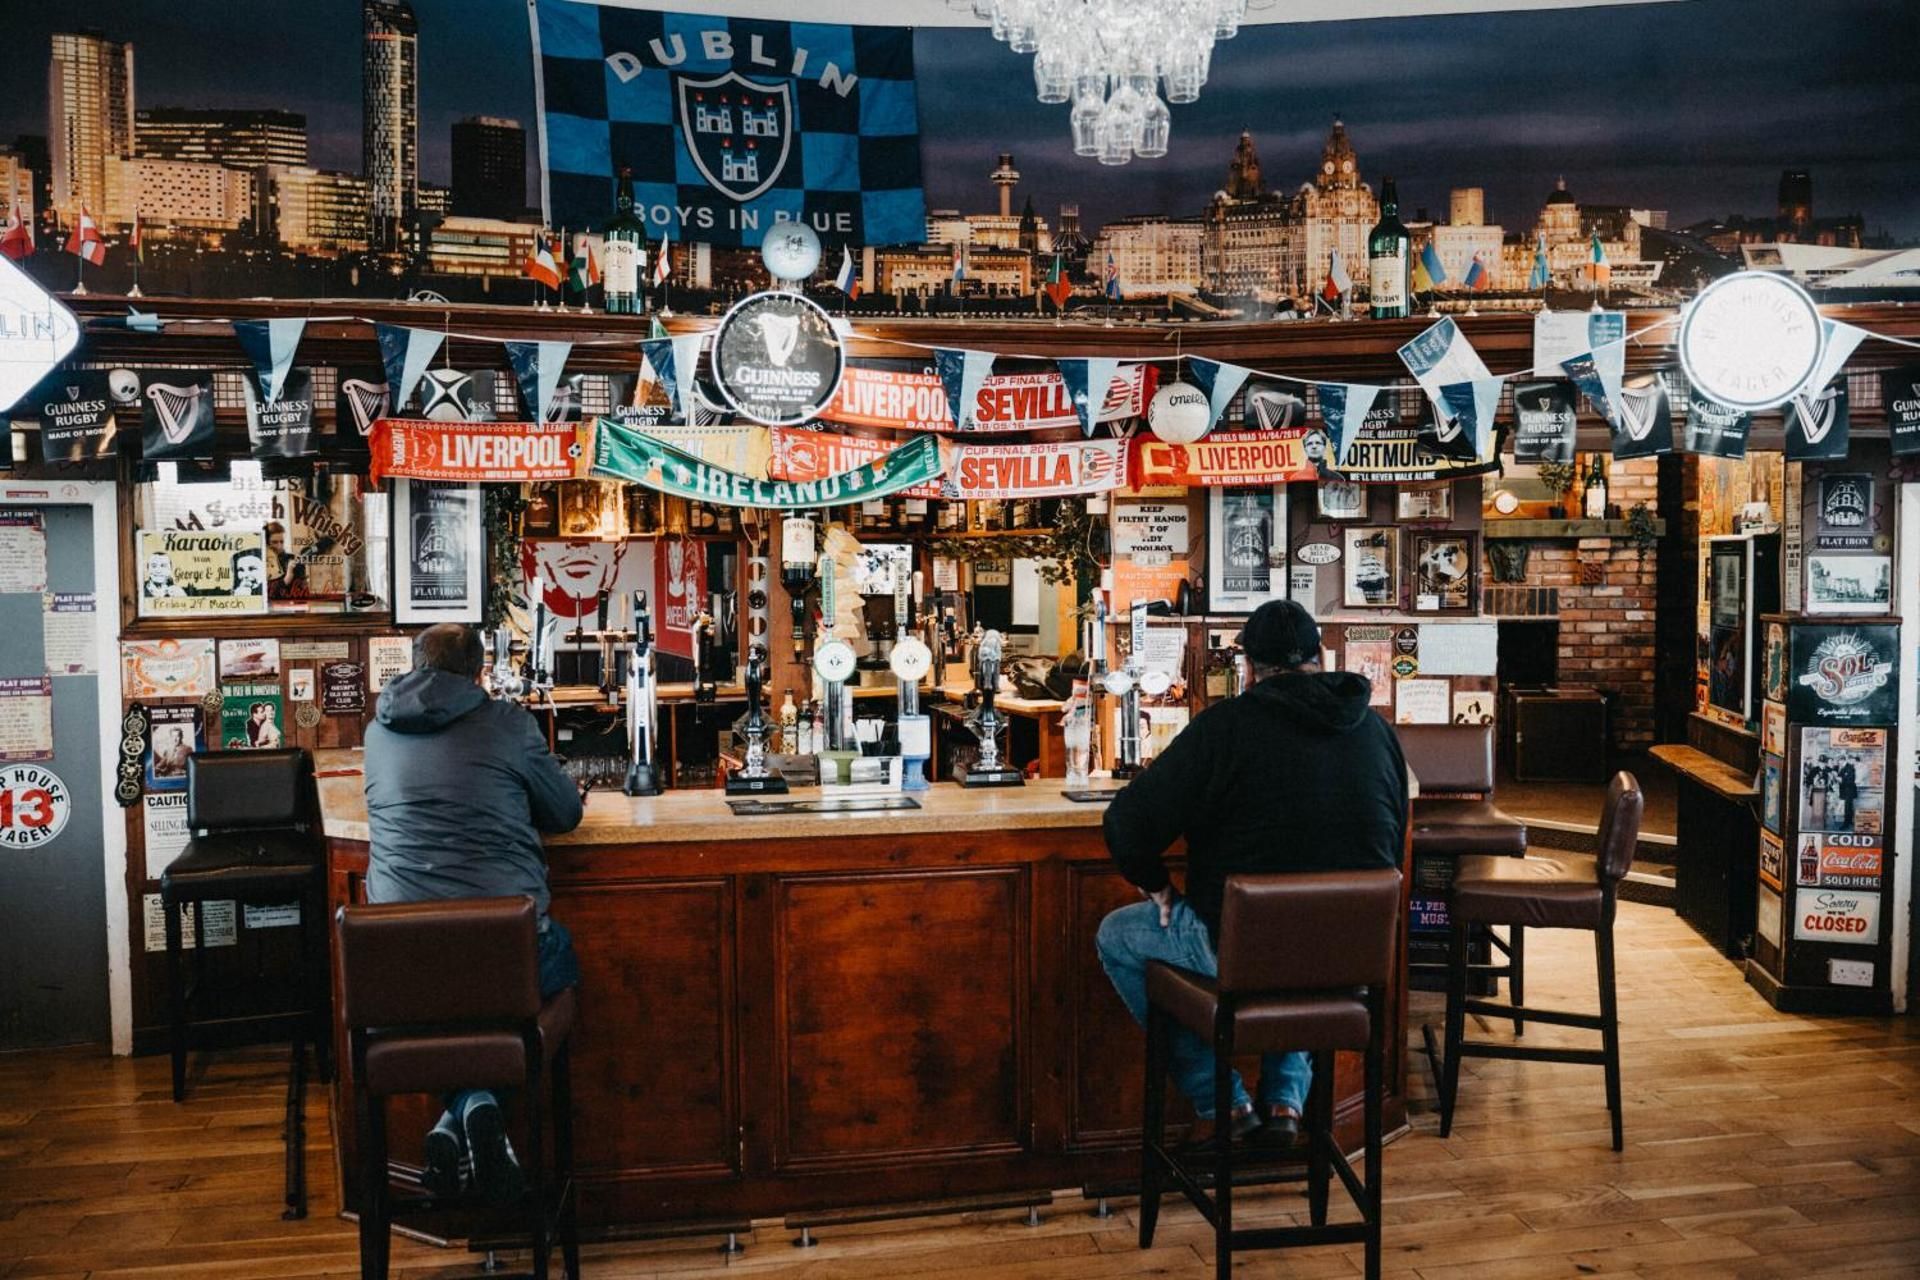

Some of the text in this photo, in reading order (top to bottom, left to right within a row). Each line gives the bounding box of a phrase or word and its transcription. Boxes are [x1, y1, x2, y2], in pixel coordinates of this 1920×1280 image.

[605, 30, 859, 99] DUBLIN
[634, 200, 714, 229] BOYS
[729, 208, 760, 231] IN
[736, 366, 821, 387] GUINNESS
[856, 370, 942, 386] EURO LEAGU
[983, 373, 1063, 387] CUP FINAL 20
[1132, 365, 1144, 413] SEVILLA
[843, 379, 954, 421] LIVERPOOL
[45, 400, 106, 416] GUINNESS
[616, 405, 666, 416] GUINNESS
[56, 413, 98, 426] RUGBY
[262, 412, 302, 424] RUGBY
[624, 416, 659, 426] RUGBY
[1520, 413, 1570, 423] GUINNESS
[1701, 413, 1739, 426] RUGBY
[545, 423, 574, 433] LEAGUE
[905, 421, 953, 430] BASEL
[1528, 424, 1563, 434] RUGBY
[1896, 426, 1916, 434] MADE
[48, 431, 71, 440] MADE
[1239, 431, 1256, 441] ROAD
[1377, 429, 1408, 439] QUARTER
[392, 428, 406, 467] LIVERPOOL
[841, 437, 879, 450] EURO
[441, 434, 568, 468] LIVERPOOL
[965, 447, 990, 456] CUP
[992, 446, 1026, 455] FINAL
[1197, 443, 1297, 471] LIVERPOOL
[1115, 438, 1127, 486] SEVILLA
[960, 454, 1073, 489] SEVILLA
[1350, 471, 1436, 481] WE'LL NEVER WALK ALONE
[695, 462, 842, 504] IRELAND
[1202, 473, 1285, 485] WE'LL NEVER WALK ALONE
[206, 495, 286, 527] Scotch
[293, 495, 362, 556] Whisky
[1117, 515, 1187, 523] FILTHY HANDS
[163, 532, 244, 551] Karaoke
[1820, 536, 1869, 545] FLAT IRON
[296, 555, 344, 565] SELECTED
[174, 568, 204, 586] George
[1225, 579, 1248, 588] FLAT
[414, 587, 464, 596] FLAT IRON
[153, 598, 246, 610] Friday March
[1134, 613, 1146, 652] CARLING
[1818, 652, 1875, 698] SOL
[20, 679, 41, 687] IRON
[15, 769, 65, 804] HOUSE
[0, 788, 55, 829] 13
[1828, 834, 1874, 847] COLD
[1825, 875, 1880, 887] SOLD HERE
[1814, 892, 1859, 911] Sorry
[1804, 914, 1867, 934] CLOSED
